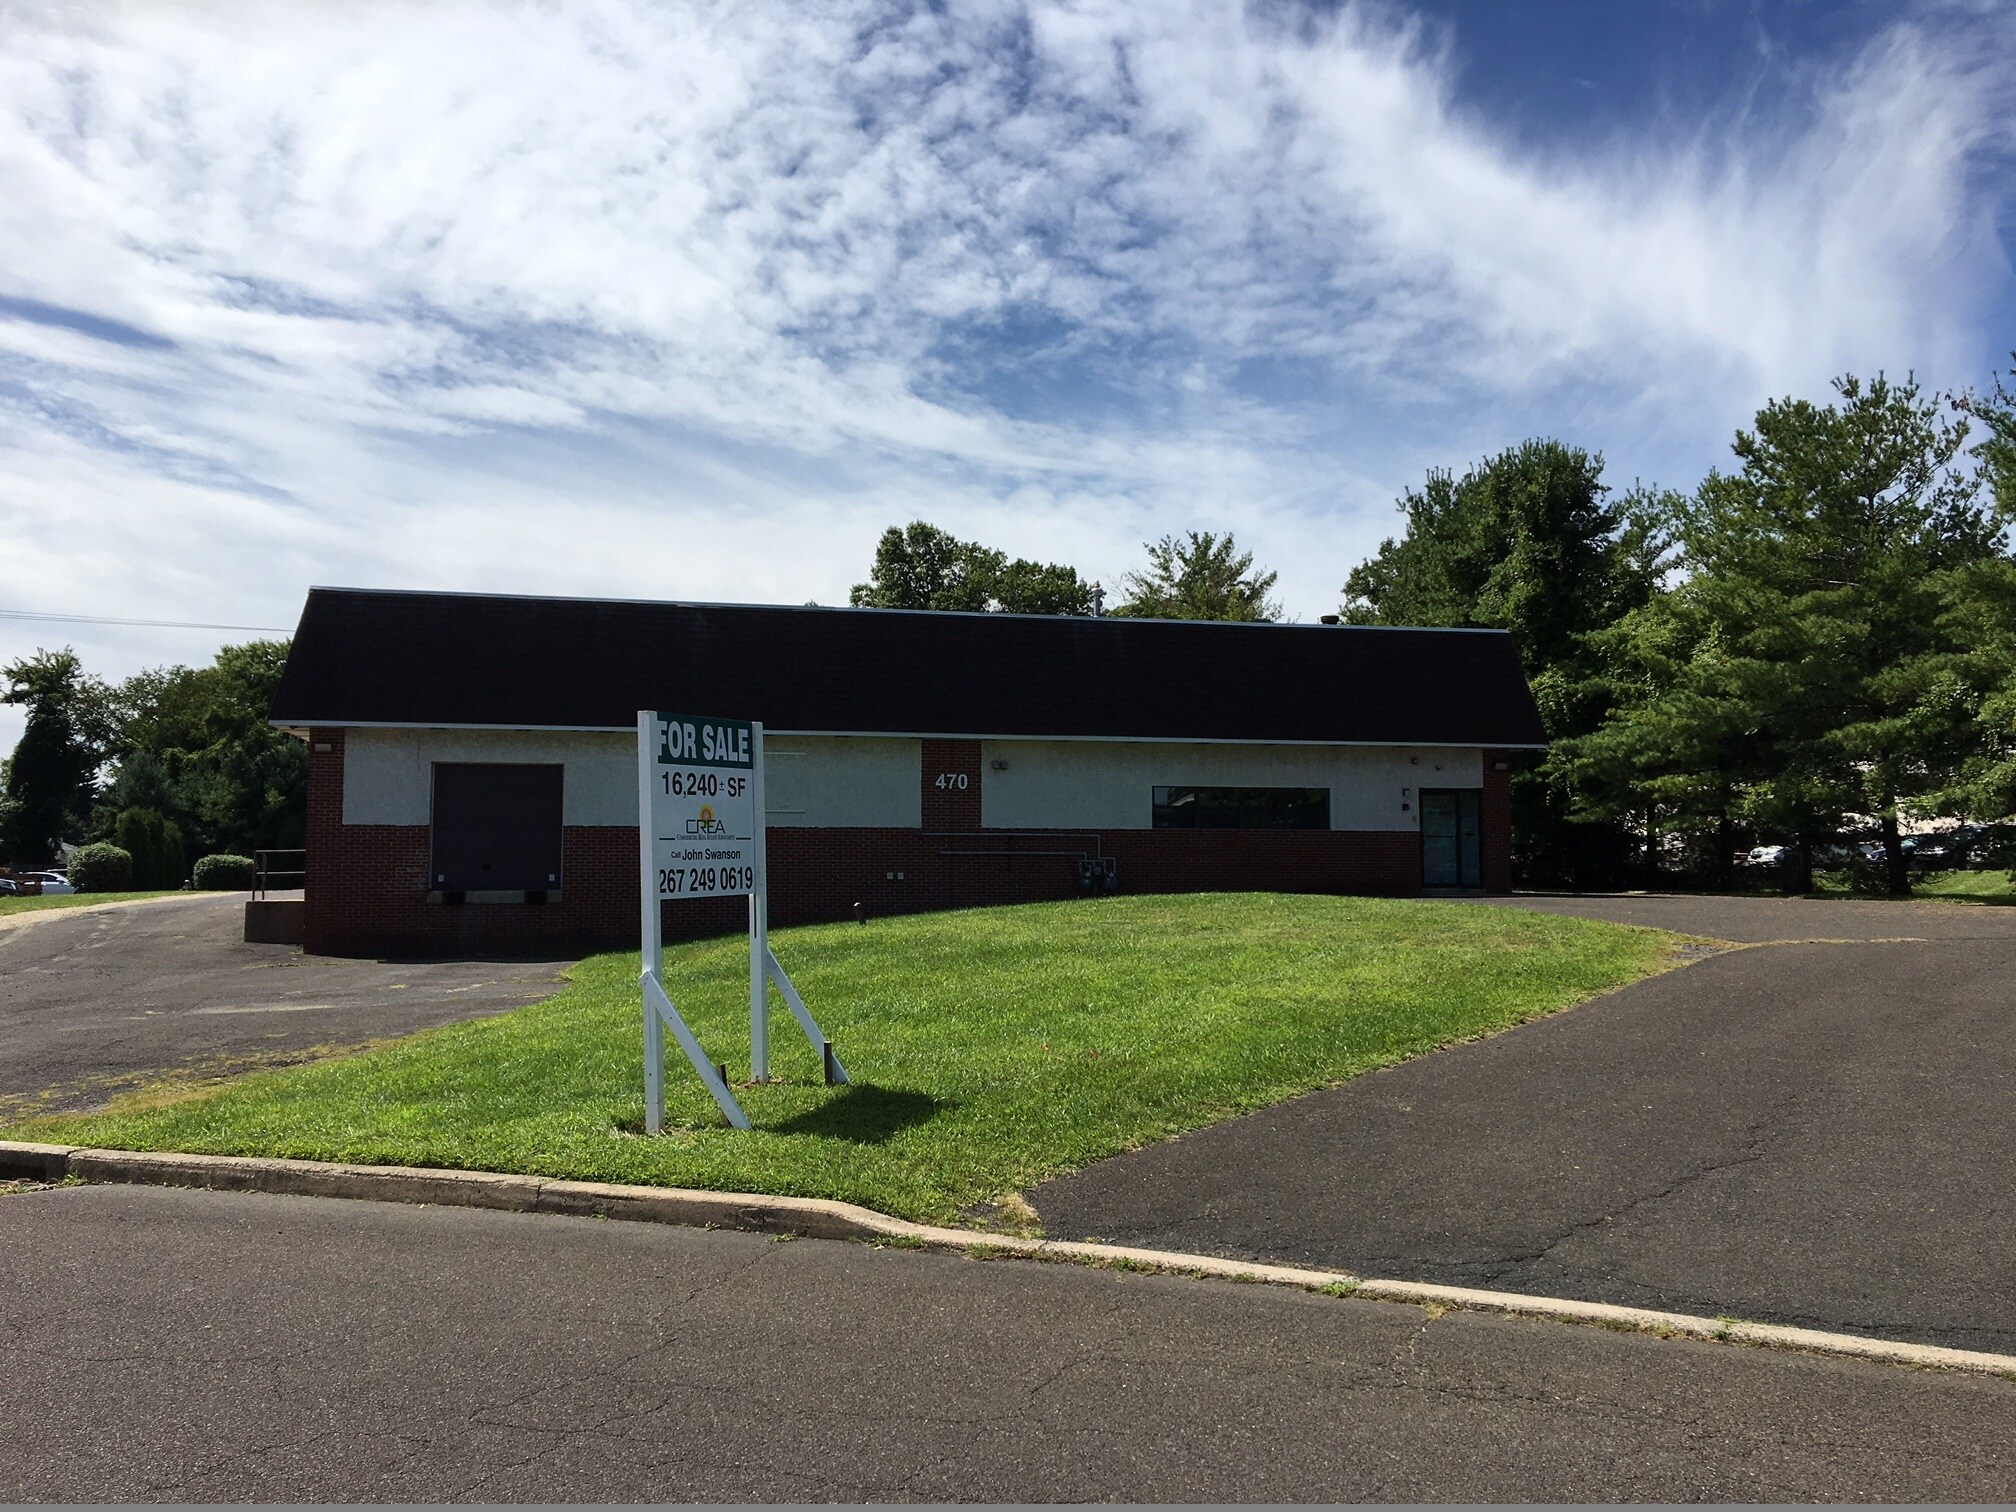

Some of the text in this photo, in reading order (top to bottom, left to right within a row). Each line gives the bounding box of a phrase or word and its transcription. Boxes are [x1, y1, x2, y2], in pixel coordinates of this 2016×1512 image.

[657, 720, 750, 762] FOR SALE
[727, 777, 746, 797] SF
[935, 773, 968, 790] 470
[686, 819, 726, 834] CREA
[682, 848, 703, 860] John
[705, 848, 741, 860] Swanson
[659, 866, 753, 893] 267 249 0619
